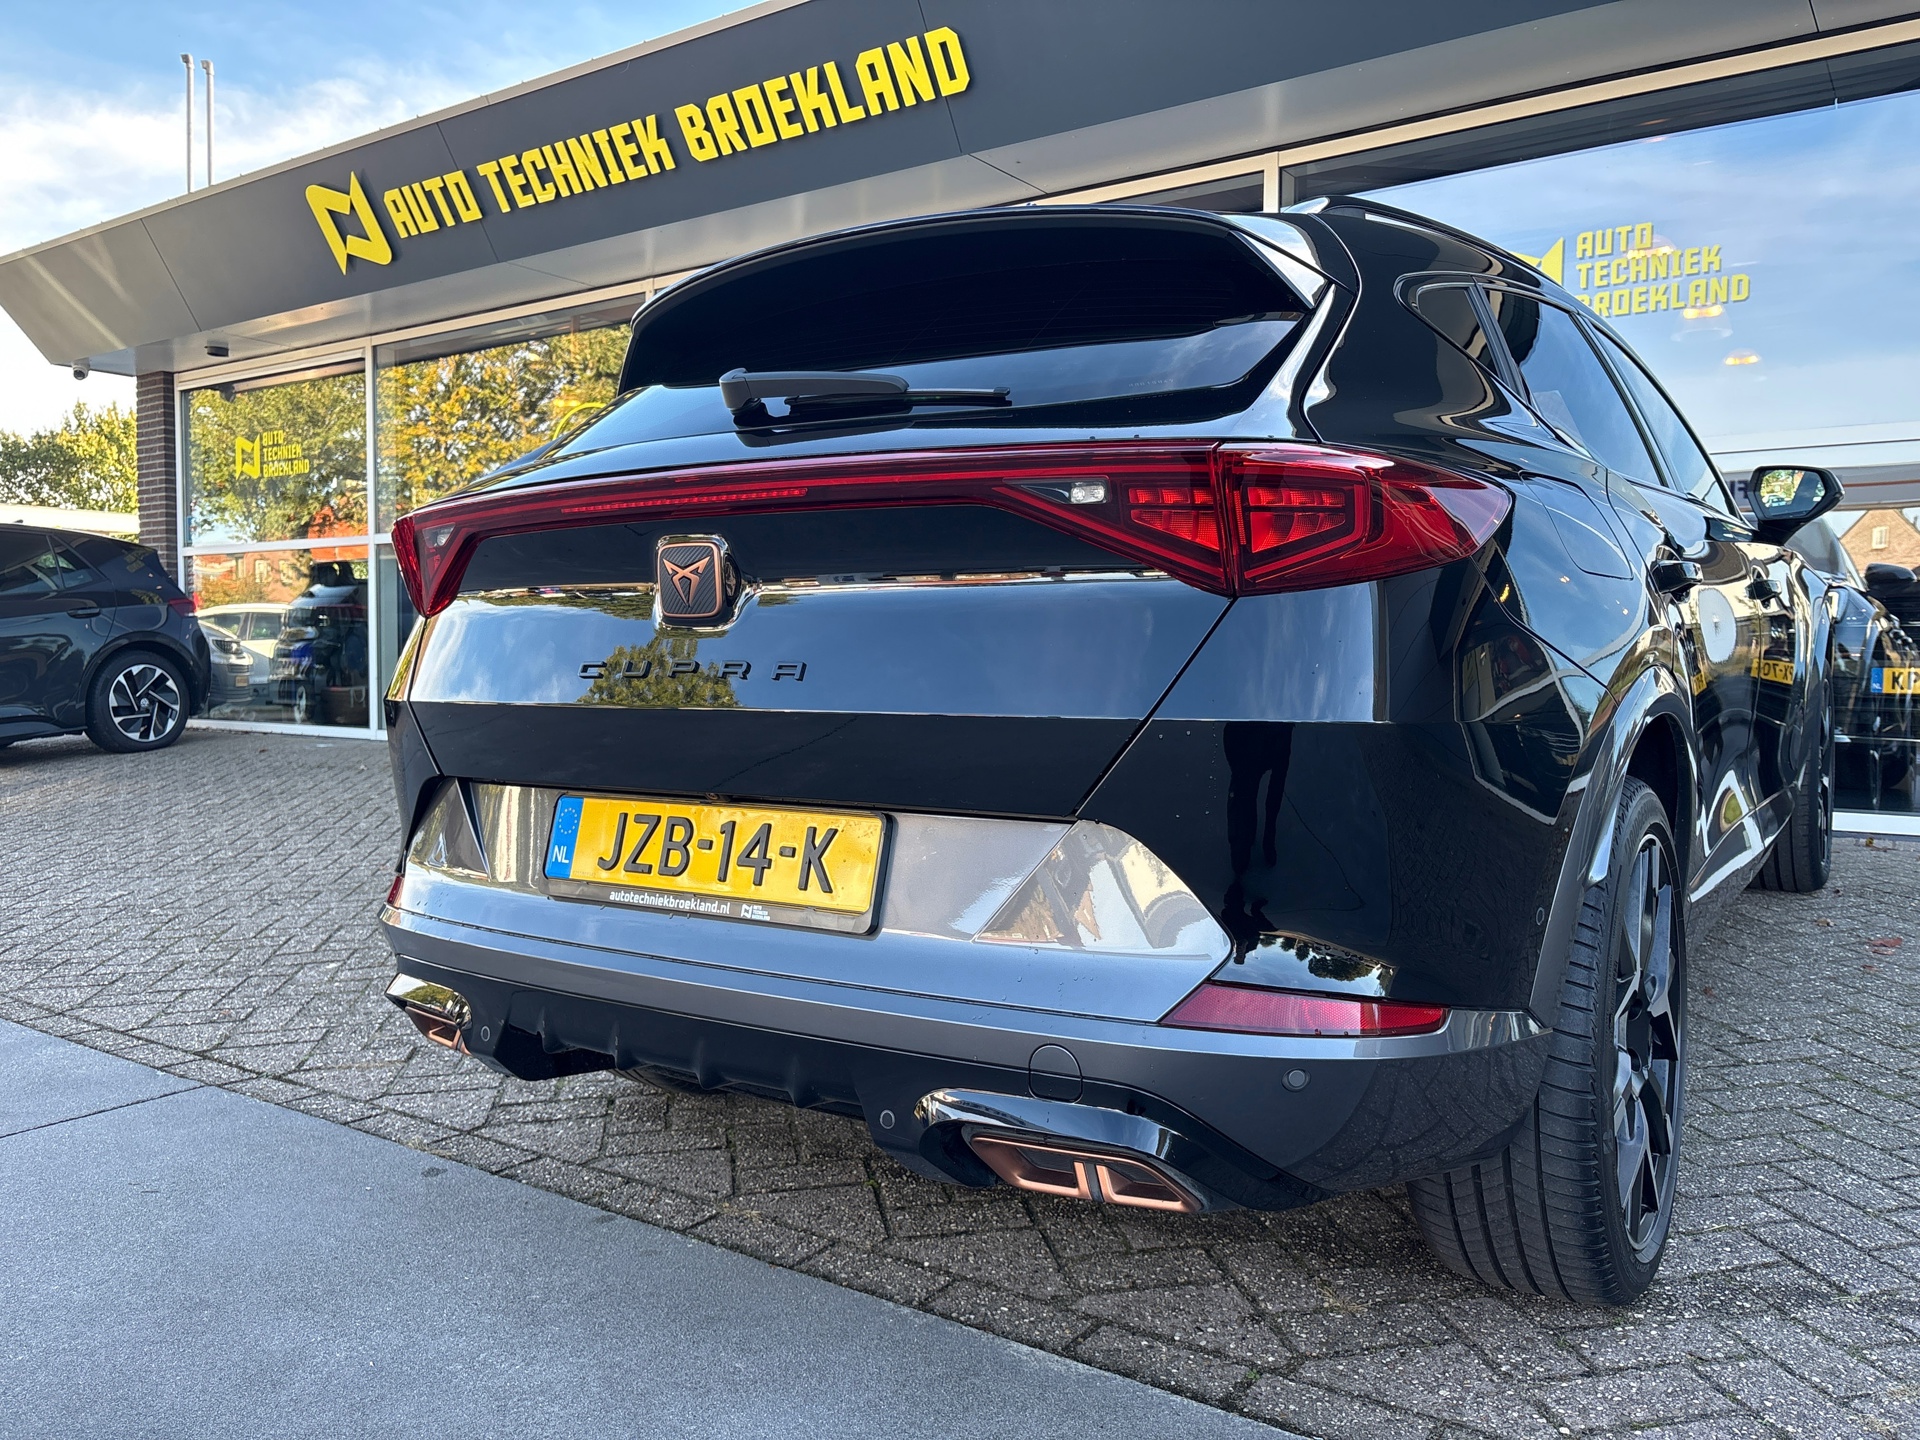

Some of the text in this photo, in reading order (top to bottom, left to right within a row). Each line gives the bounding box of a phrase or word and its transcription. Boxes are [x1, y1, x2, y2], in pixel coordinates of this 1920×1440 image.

[383, 26, 970, 239] AUTO TECHNIEK BROEKLAND
[1576, 222, 1654, 259] AUTO
[1576, 244, 1721, 289] TECHNIEK
[262, 430, 283, 446] AUTO
[263, 443, 302, 461] TECHNIEK
[262, 459, 310, 478] BROEKLAND
[578, 659, 808, 681] CUPRA
[552, 844, 570, 864] NL
[597, 811, 839, 894] JZB-14-K
[609, 890, 731, 915] autotechniekbroekland.nl
